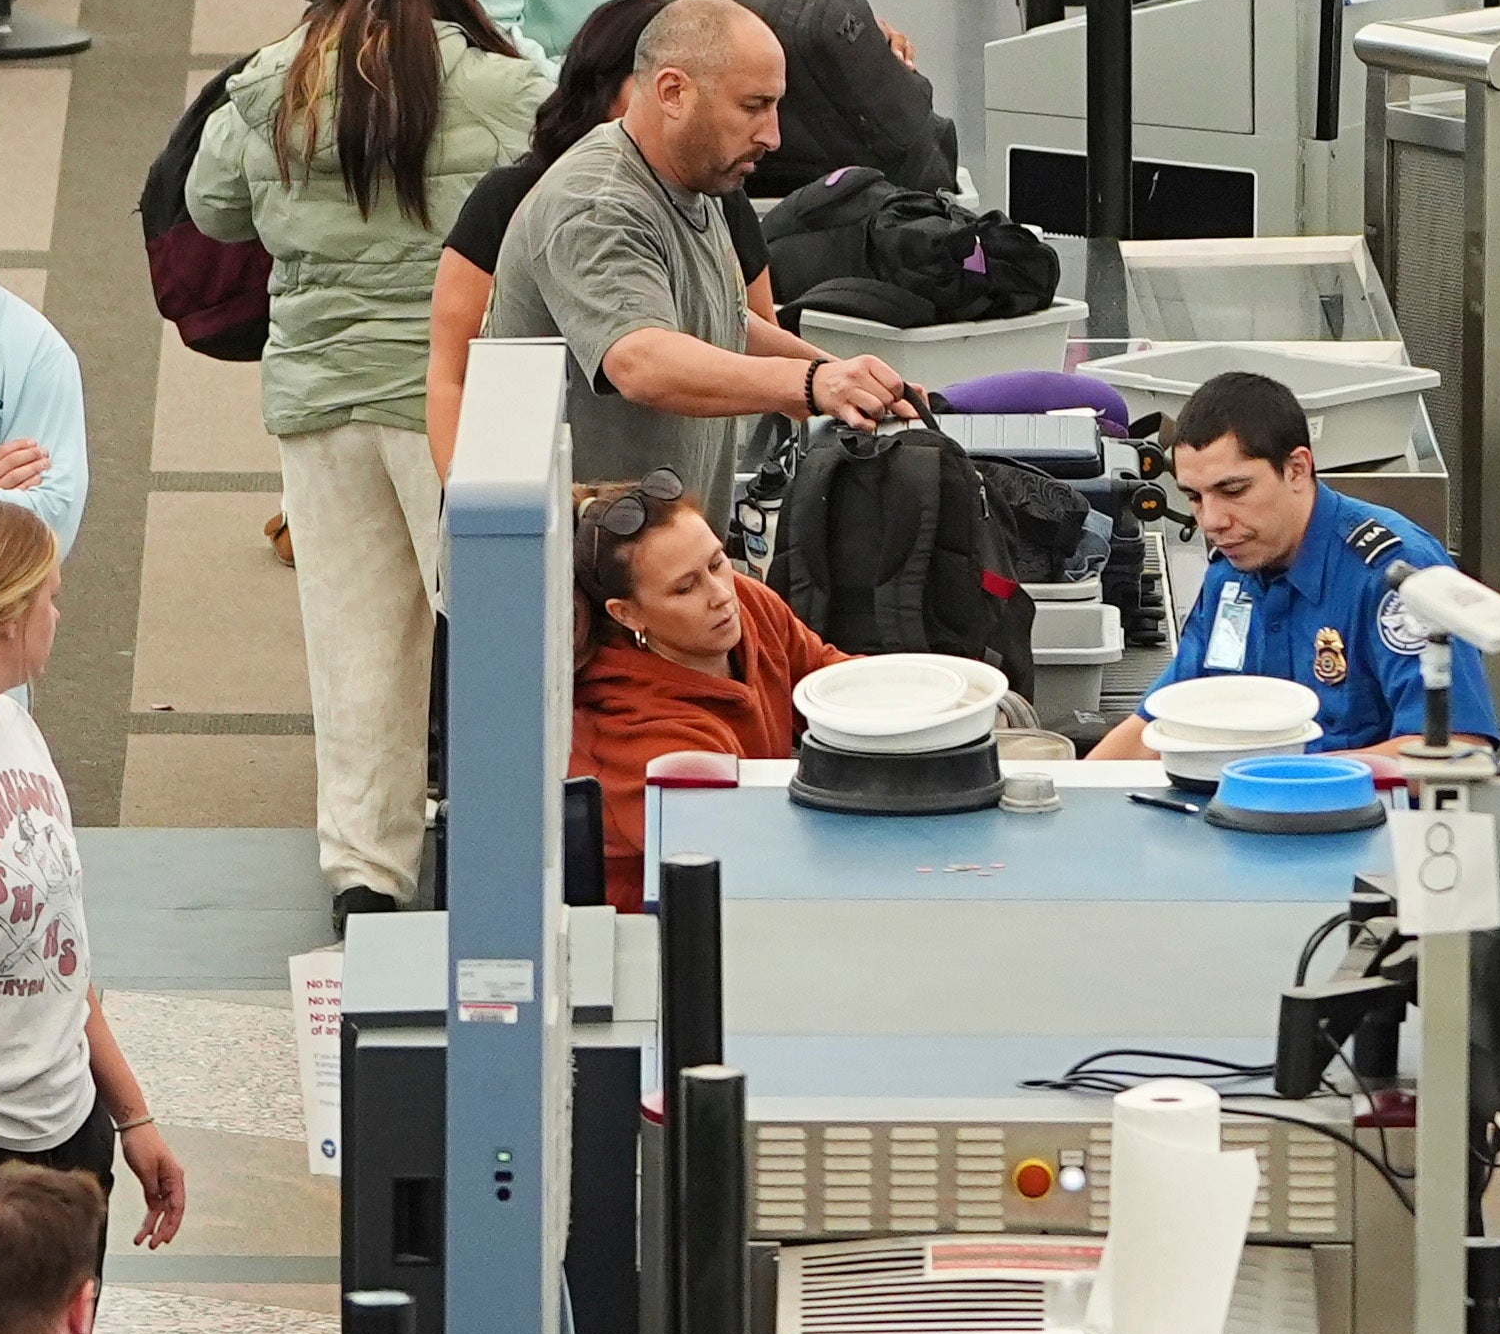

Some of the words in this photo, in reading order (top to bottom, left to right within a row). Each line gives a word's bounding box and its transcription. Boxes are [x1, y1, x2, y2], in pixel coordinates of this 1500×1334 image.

[1418, 821, 1462, 892] 8
[306, 980, 323, 990] No
[308, 997, 325, 1006] No
[310, 1013, 326, 1023] No
[311, 1025, 323, 1036] of
